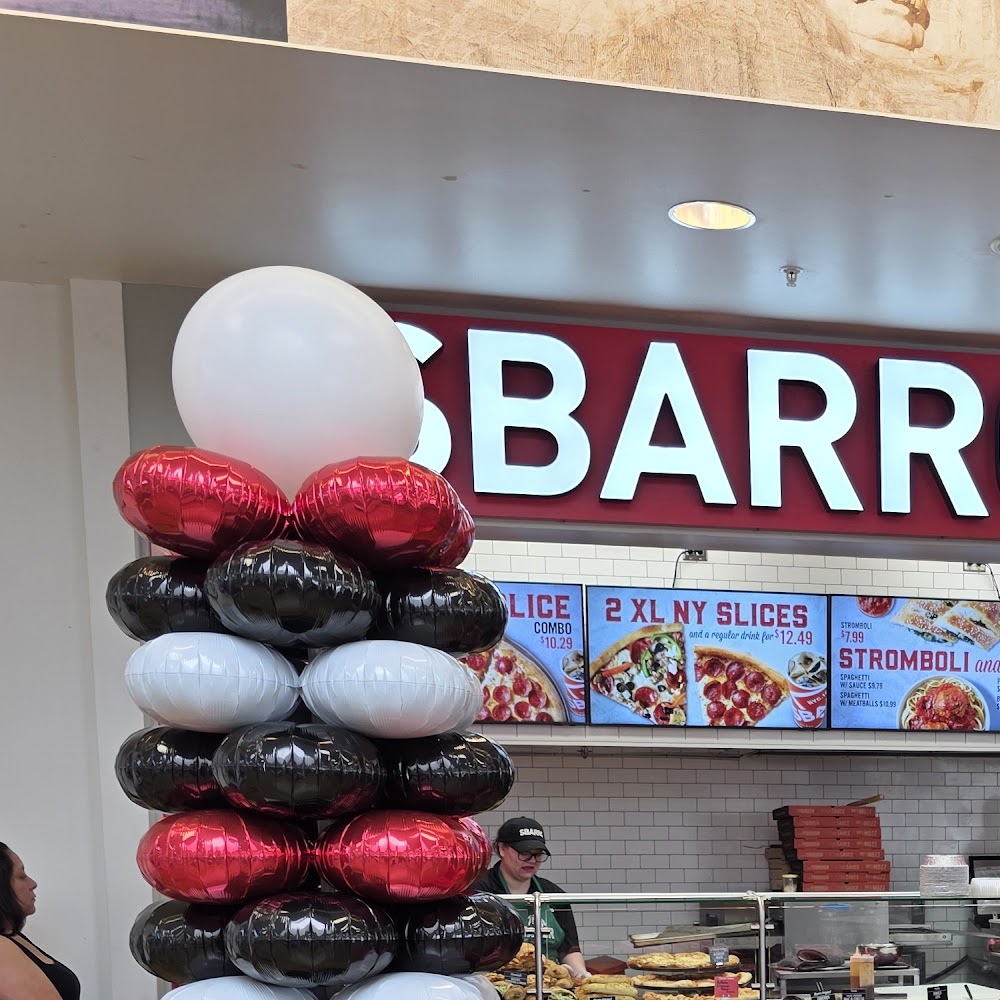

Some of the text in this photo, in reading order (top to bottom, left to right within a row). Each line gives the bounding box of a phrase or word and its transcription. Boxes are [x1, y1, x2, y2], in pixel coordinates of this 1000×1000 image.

[501, 593, 570, 619] LICE
[606, 598, 808, 628] 2 XL NY SLICES
[534, 621, 572, 635] COMBO
[841, 621, 873, 630] STROMBOLI
[540, 636, 573, 649] $10.29
[689, 630, 703, 639] and
[711, 629, 739, 643] regular
[740, 630, 760, 641] drink
[761, 630, 774, 644] for
[774, 629, 813, 646] $12.49
[841, 631, 864, 644] $7.99
[839, 648, 970, 673] STROMBOLI
[840, 673, 870, 682] SPAGHETTI
[849, 681, 867, 690] SAUCE
[840, 691, 870, 700] SPAGHETTI
